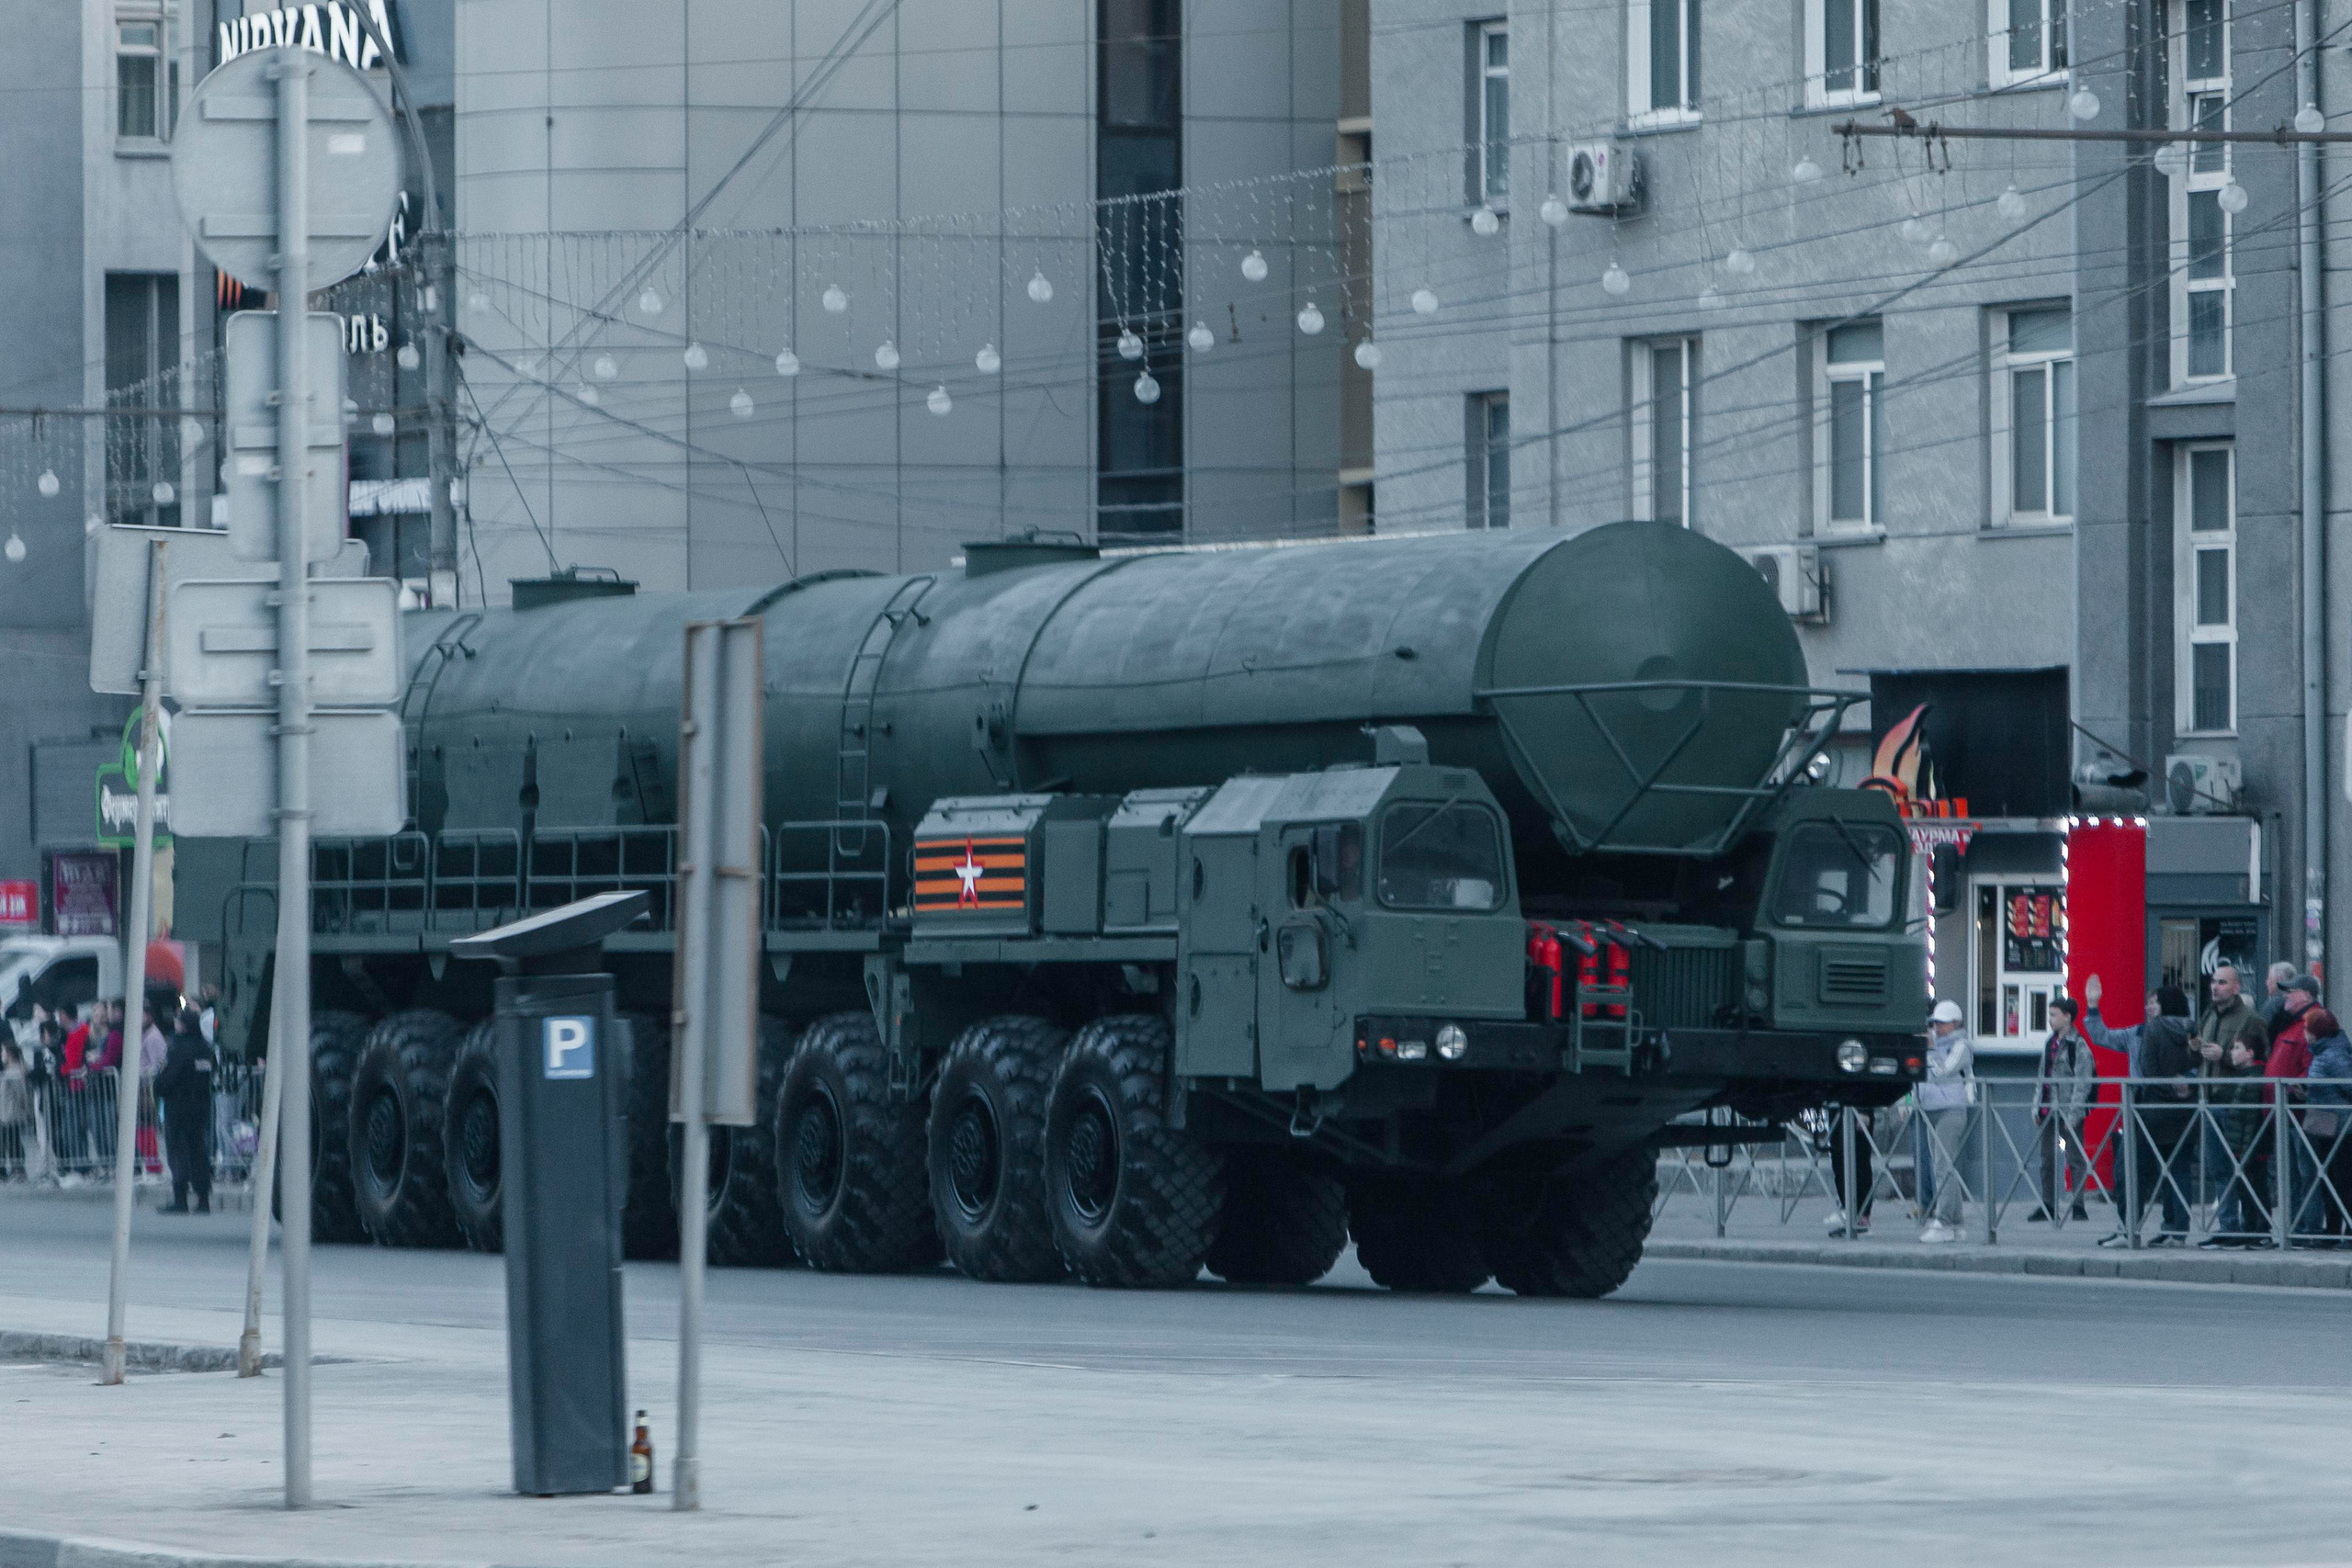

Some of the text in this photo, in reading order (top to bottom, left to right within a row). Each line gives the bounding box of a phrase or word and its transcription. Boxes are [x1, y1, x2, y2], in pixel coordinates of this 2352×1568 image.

[220, 0, 394, 70] NIRVANA
[1908, 828, 1960, 844] АУРМА
[549, 1020, 585, 1068] P
